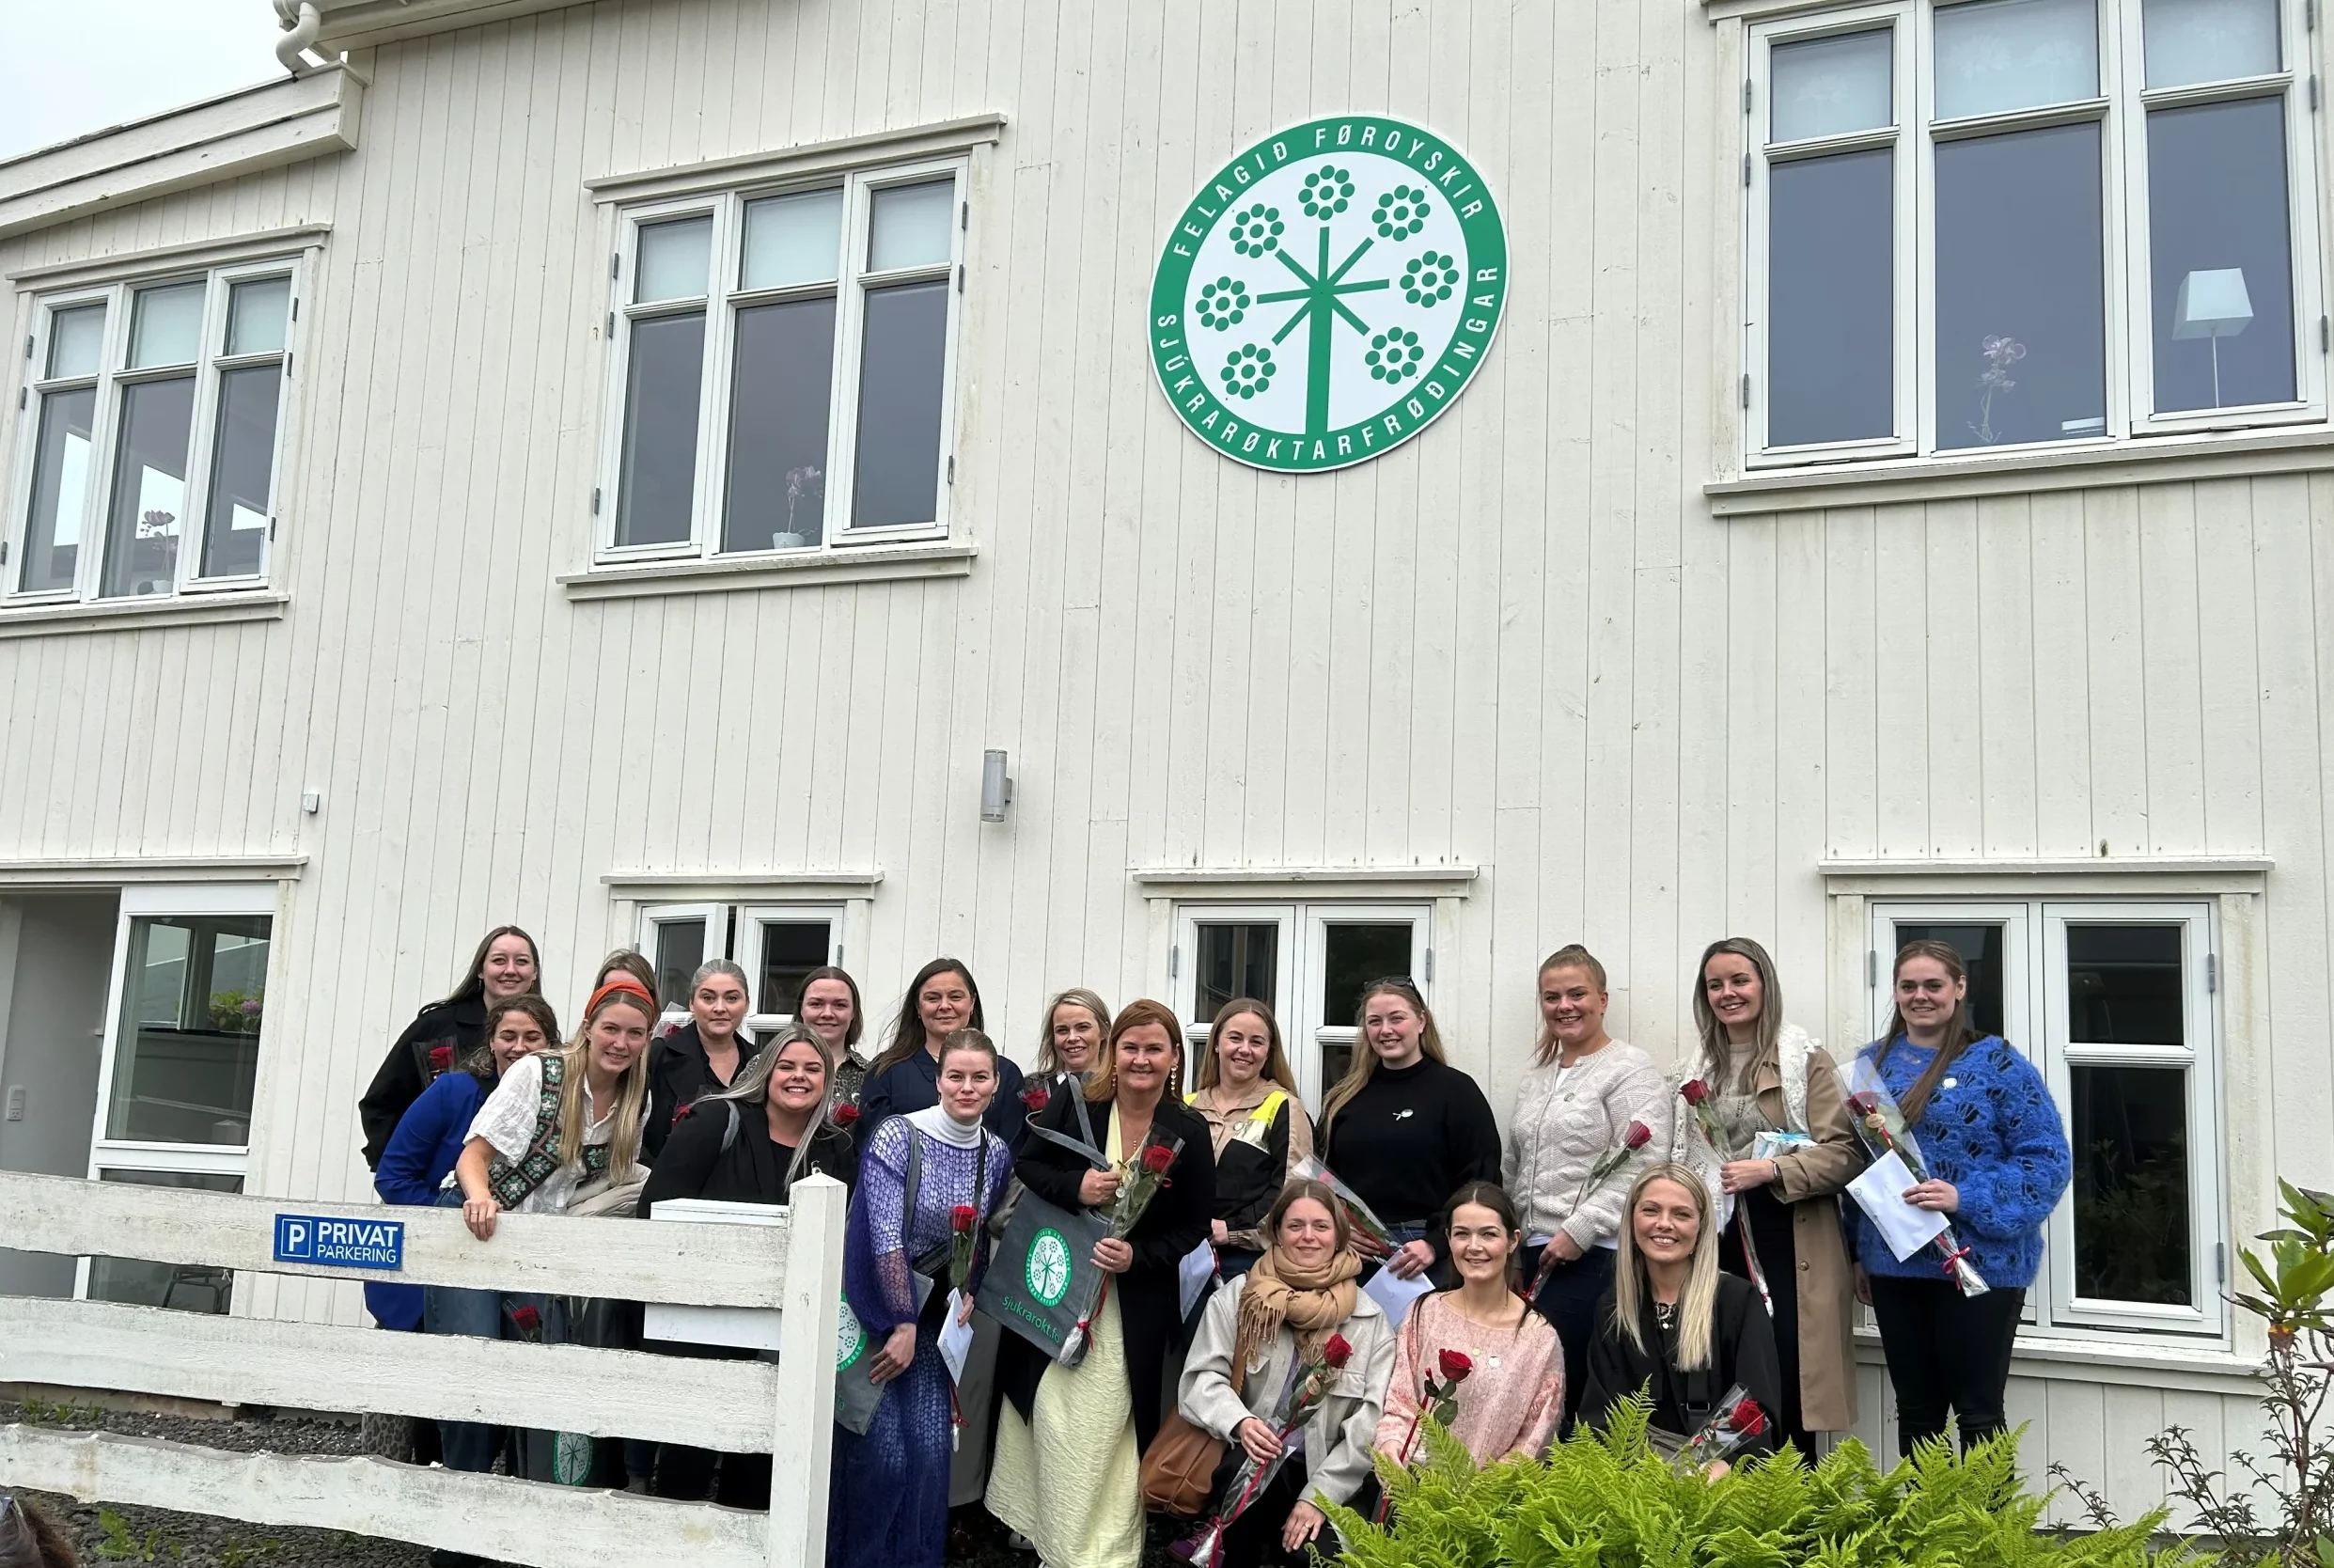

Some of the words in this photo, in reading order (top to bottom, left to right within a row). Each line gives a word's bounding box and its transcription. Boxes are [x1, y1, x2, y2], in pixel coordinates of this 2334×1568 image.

[1173, 141, 1288, 258] FELAGIÐ
[1315, 124, 1483, 220] FØROYSKIR
[1157, 266, 1497, 461] SJÚKRARØKTARFRØÐINGAR
[289, 1224, 305, 1252] P
[318, 1222, 399, 1247] PRIVAT
[317, 1245, 397, 1263] PARKERING
[1002, 1294, 1060, 1343] sjukrarokt.fo
